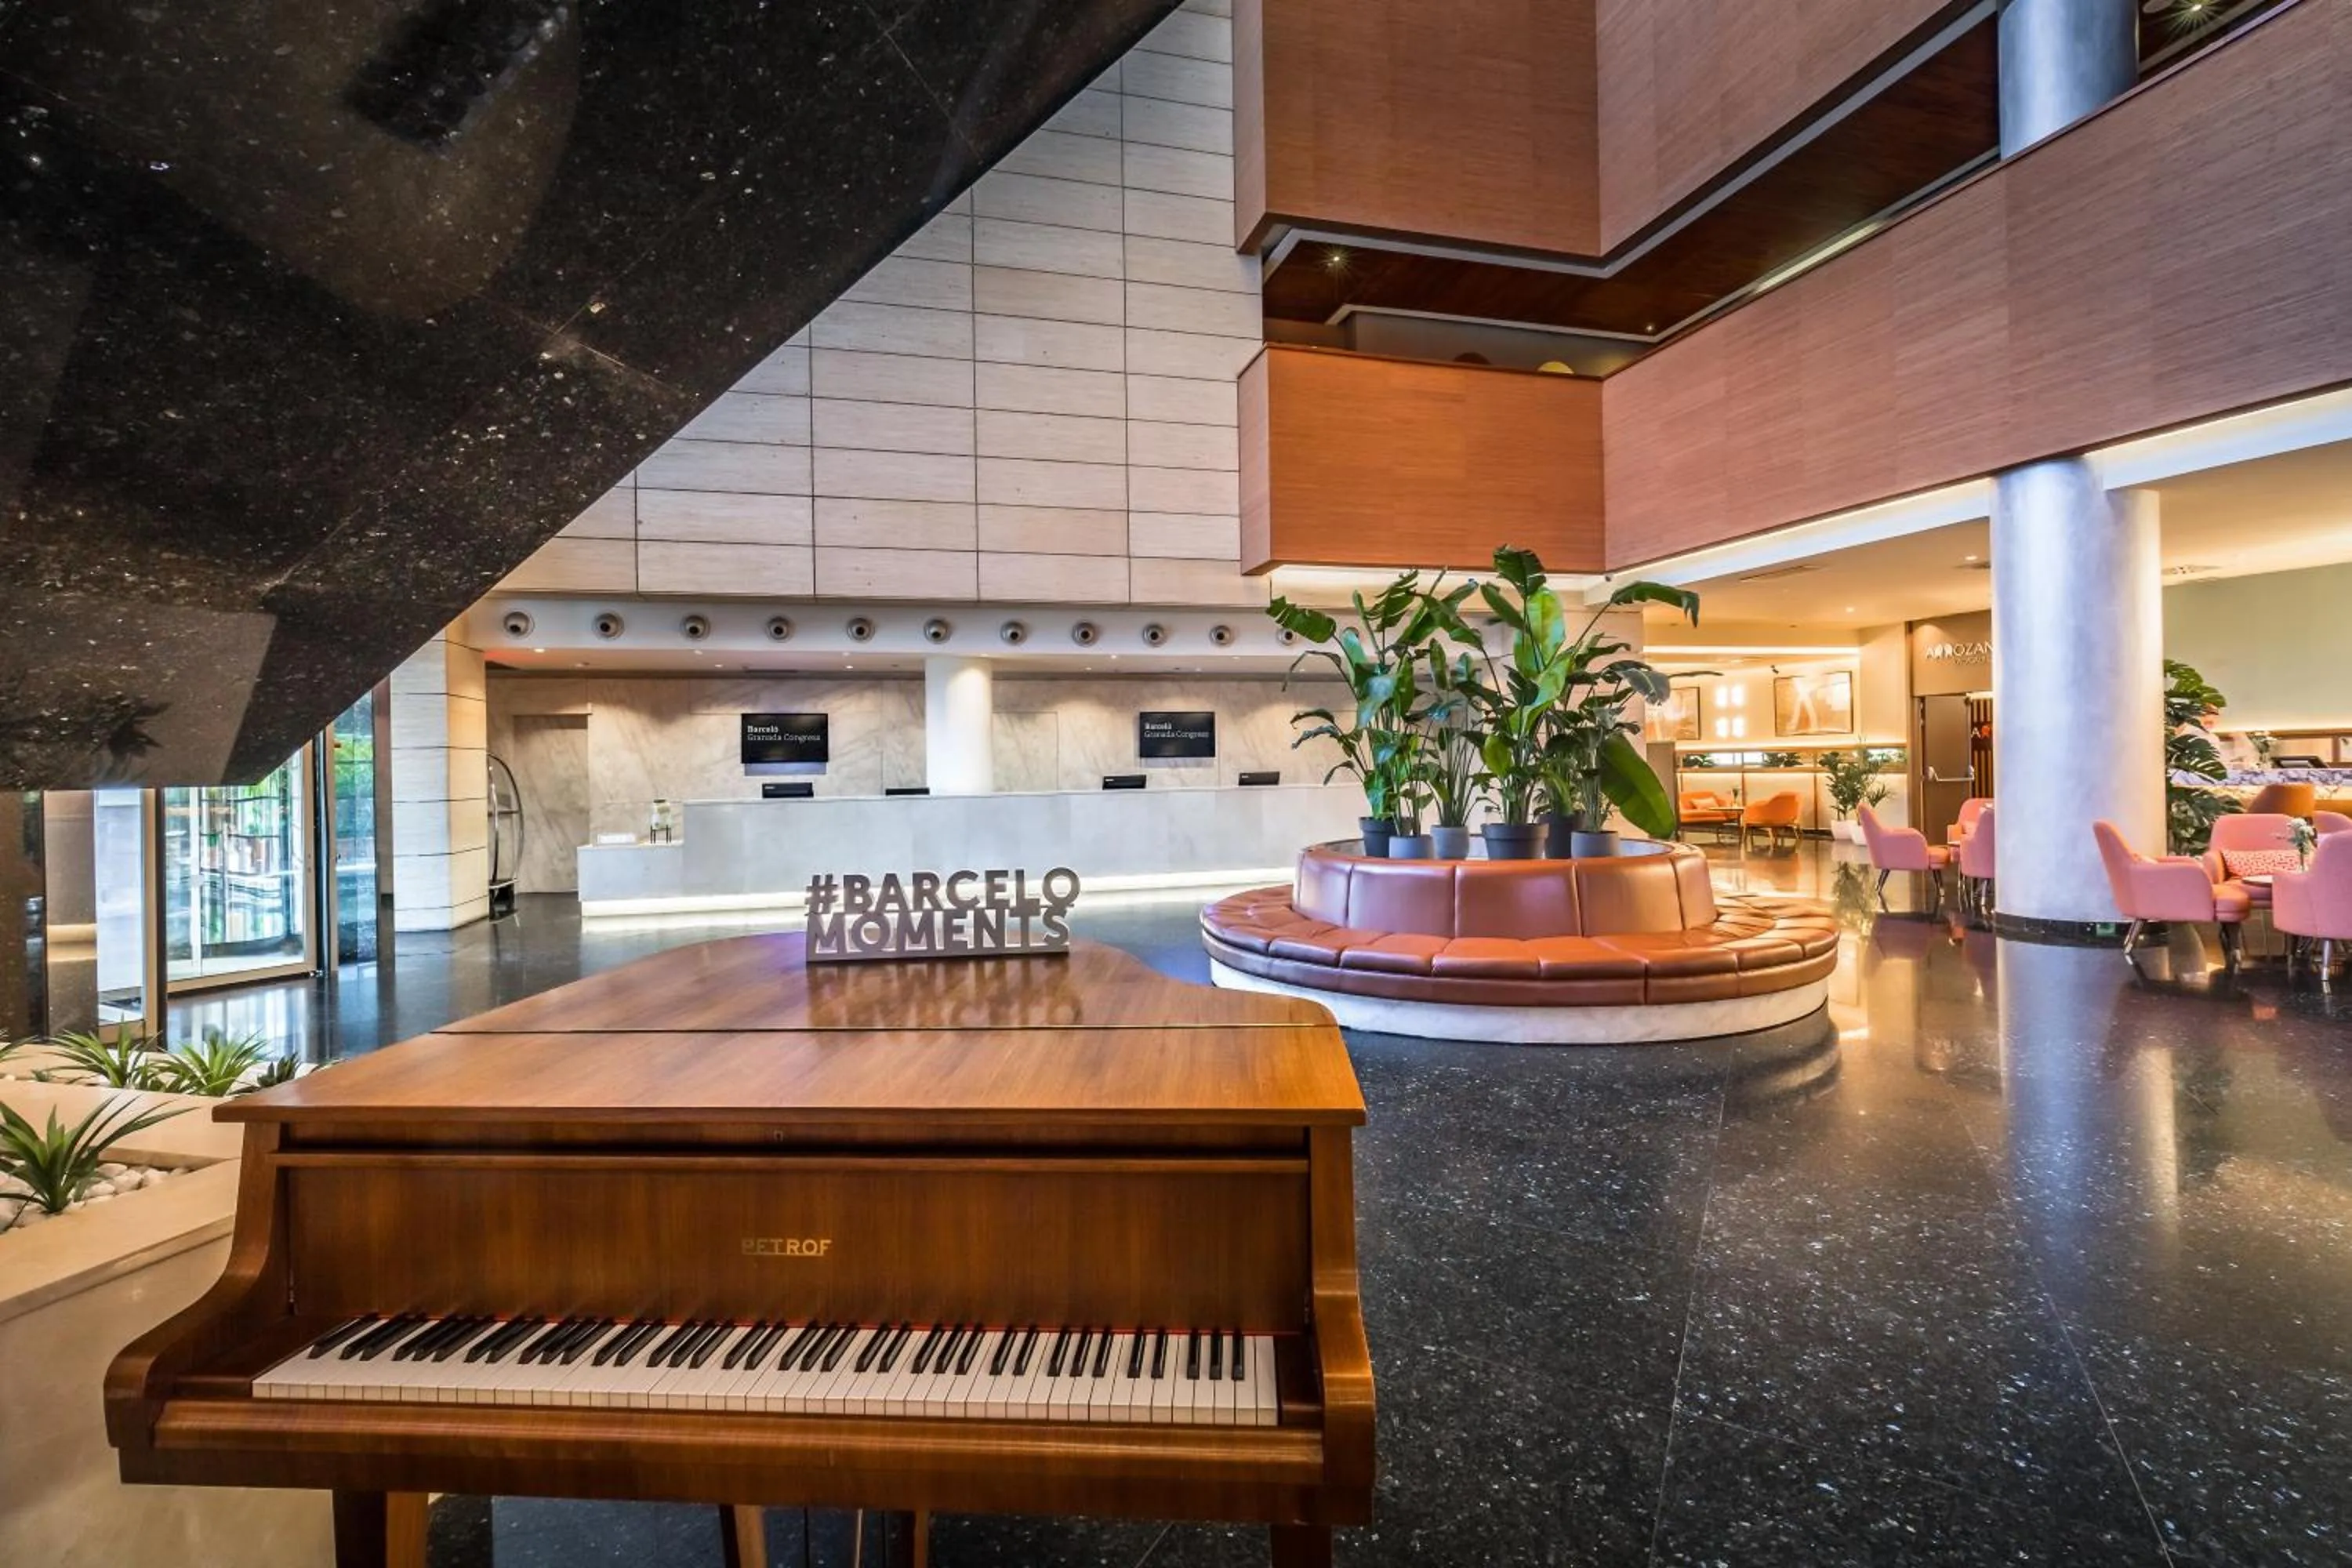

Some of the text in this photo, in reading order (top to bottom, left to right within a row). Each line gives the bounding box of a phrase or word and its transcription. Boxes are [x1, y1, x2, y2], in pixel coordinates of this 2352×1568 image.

[804, 866, 1081, 914] #BARCELO
[806, 906, 1070, 958] MOMENTS
[742, 1238, 833, 1256] PETROF
